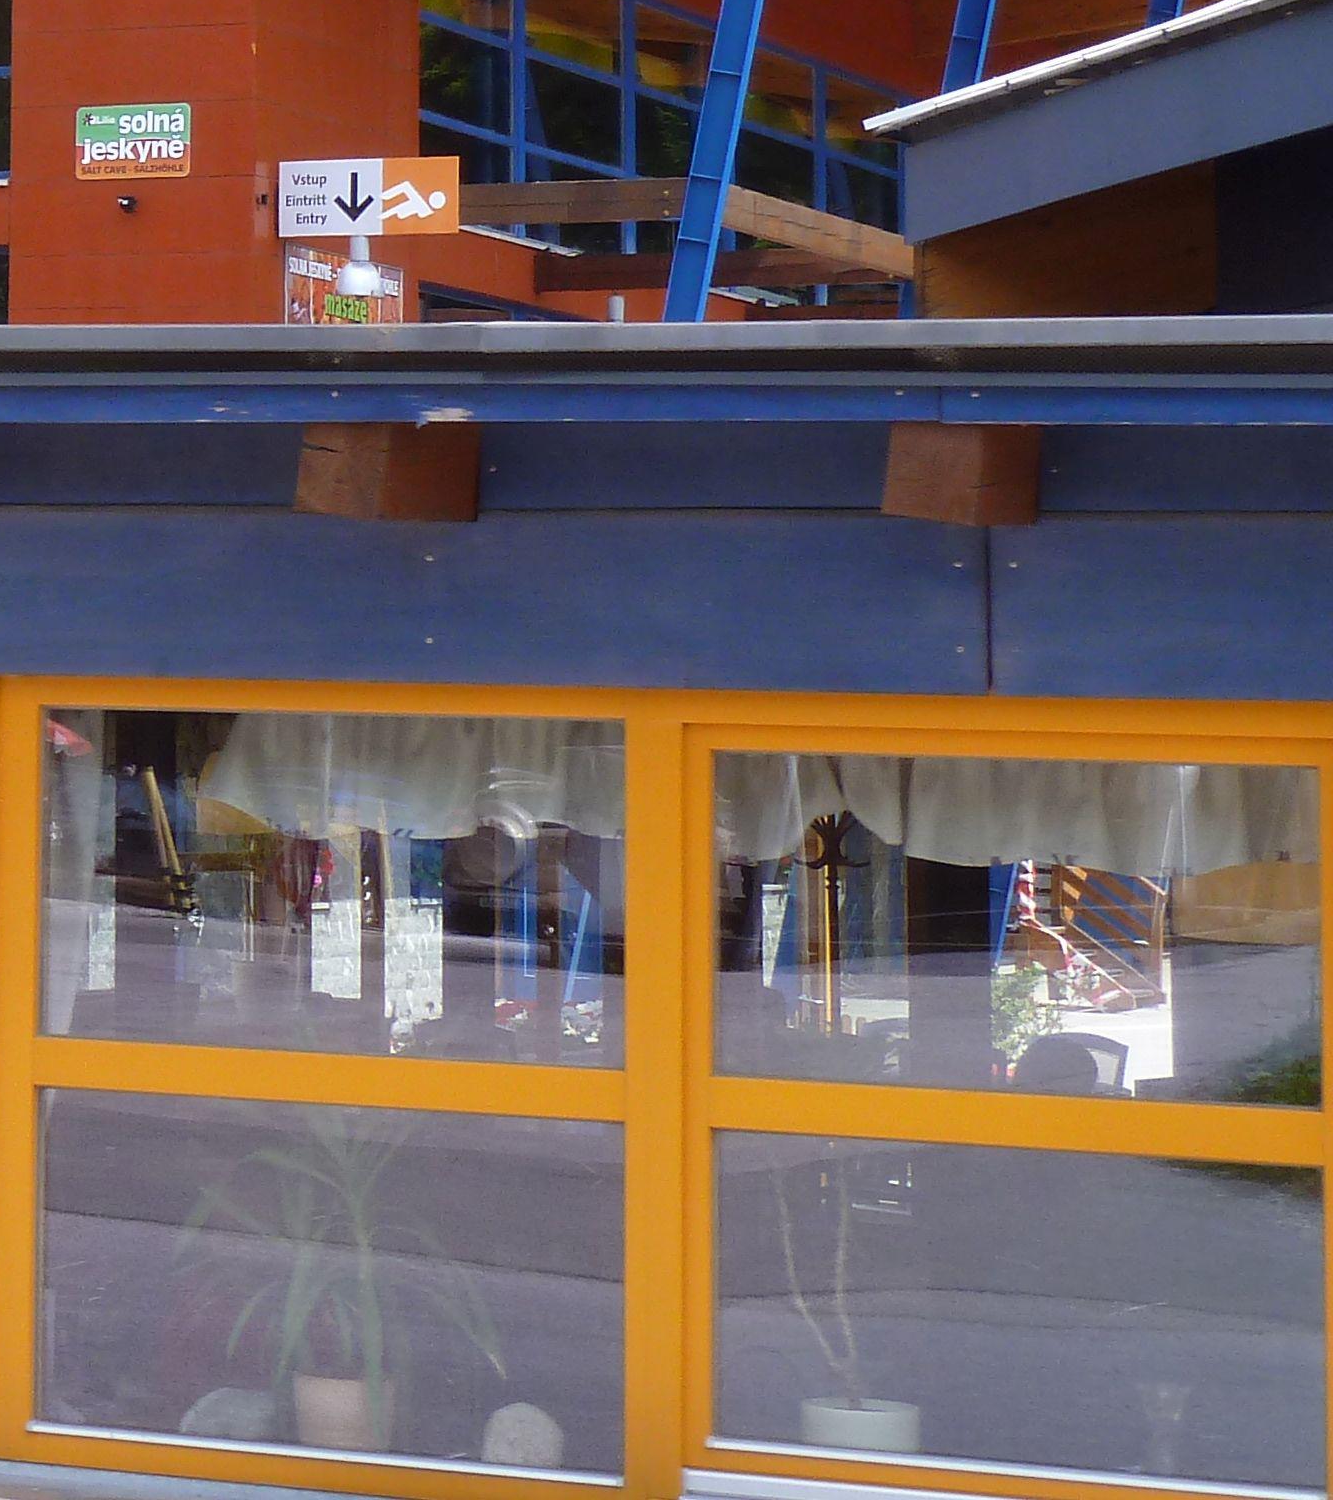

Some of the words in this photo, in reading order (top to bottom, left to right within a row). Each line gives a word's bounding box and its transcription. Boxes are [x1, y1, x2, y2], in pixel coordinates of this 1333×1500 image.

[119, 108, 185, 134] solná
[81, 134, 185, 165] jeskyně
[291, 174, 327, 188] Vstup
[285, 194, 327, 207] Eintritt
[296, 213, 328, 225] Entry
